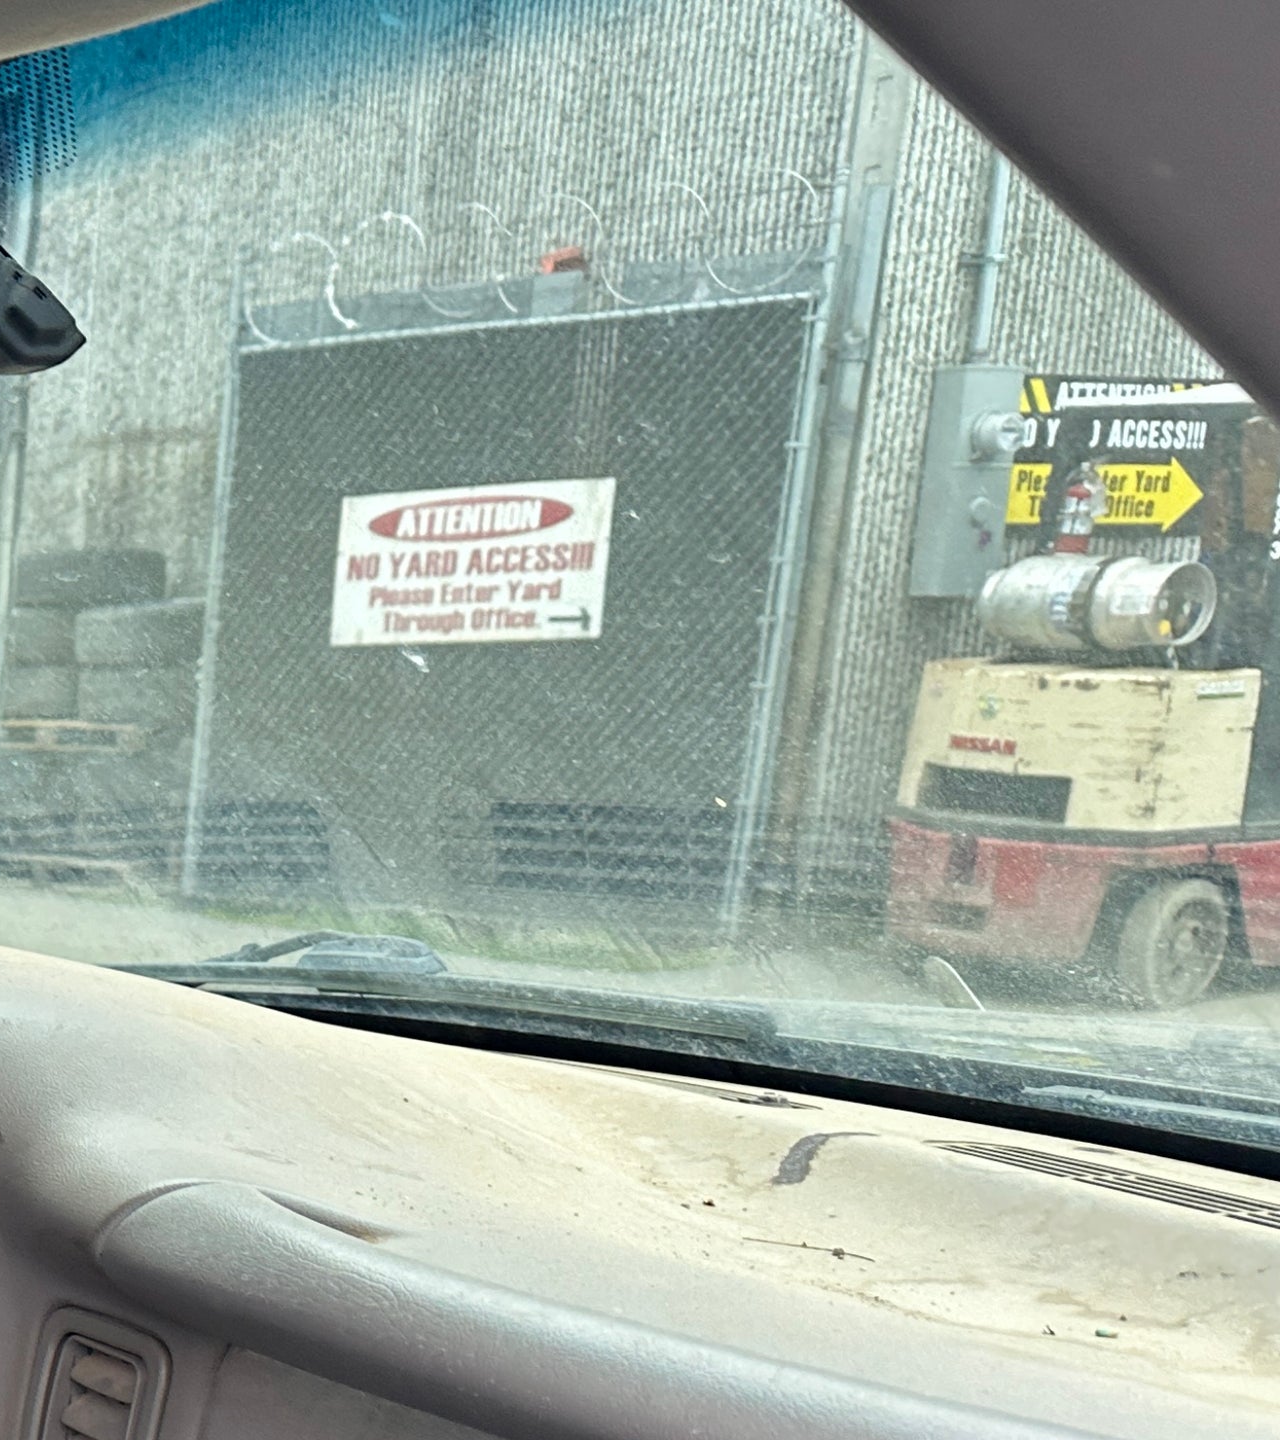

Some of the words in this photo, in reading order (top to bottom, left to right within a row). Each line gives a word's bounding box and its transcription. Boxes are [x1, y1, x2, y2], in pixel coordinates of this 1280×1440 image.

[1107, 418, 1208, 450] ACCESS!!!
[1135, 470, 1172, 493] Yard
[396, 499, 542, 537] ATTENTION
[347, 554, 381, 581] NO
[390, 549, 459, 579] YARD
[466, 542, 596, 575] ACCESS!!!
[369, 584, 435, 608] Please
[441, 581, 501, 605] Enter
[508, 578, 563, 602] Yard
[384, 608, 466, 634] Through
[948, 734, 1018, 756] NISSAN
